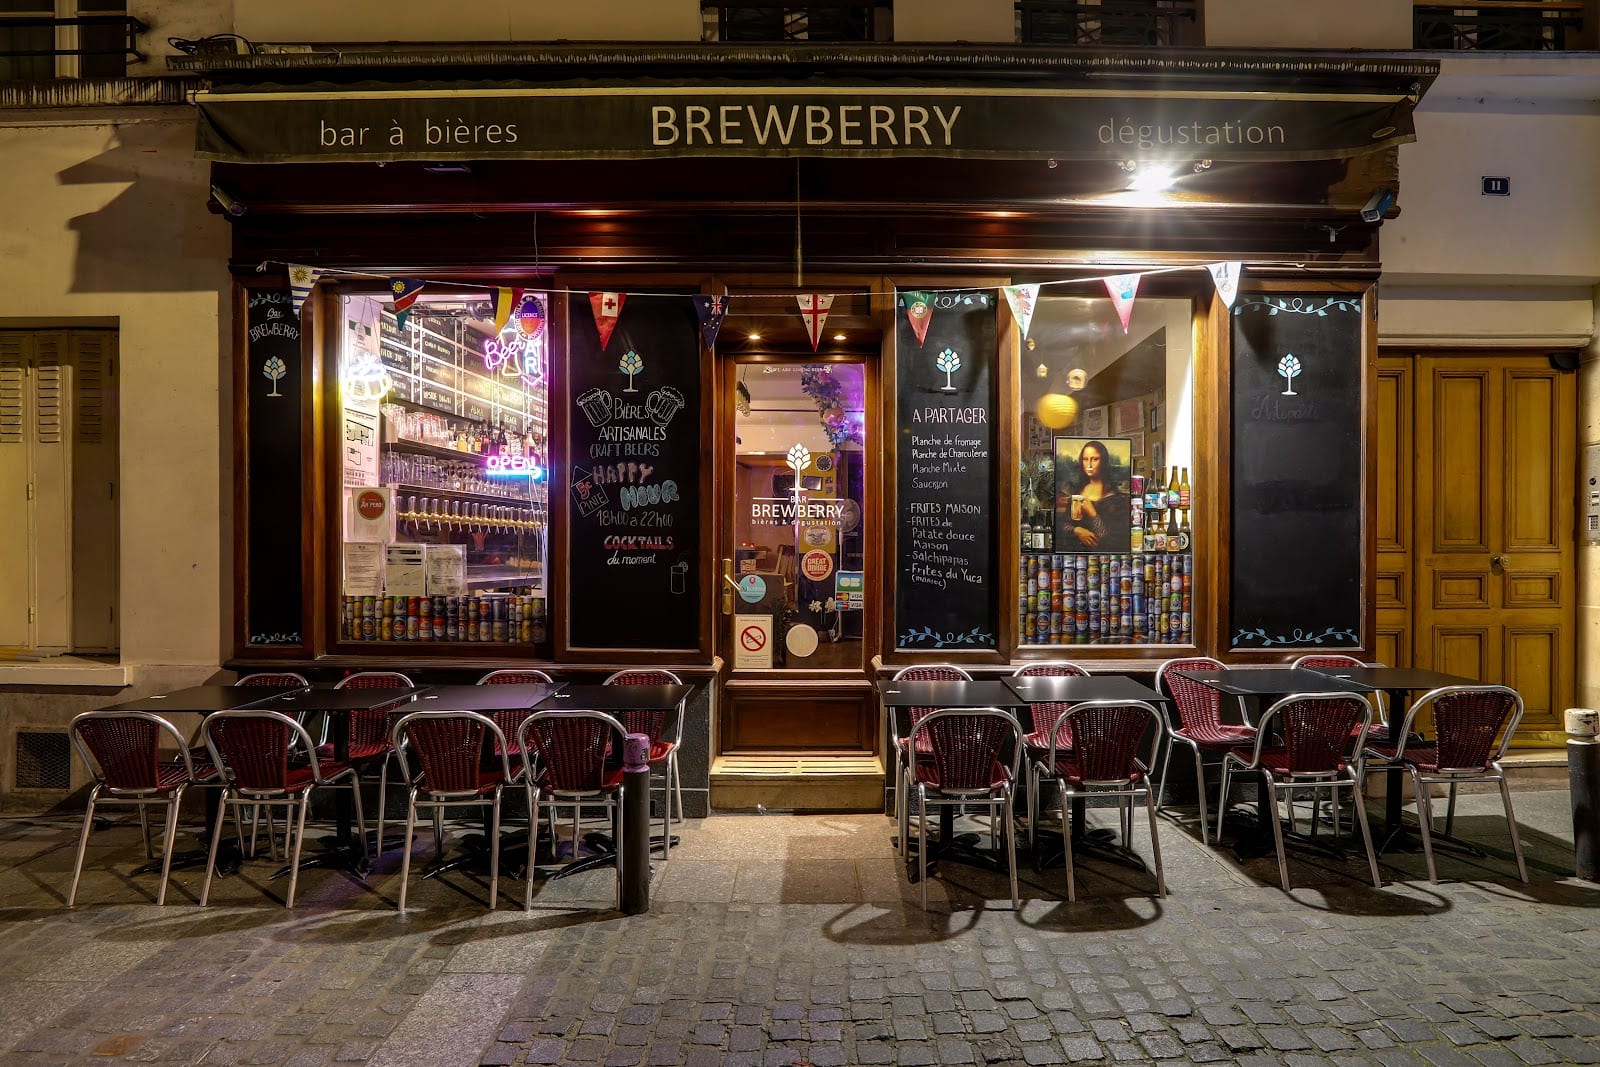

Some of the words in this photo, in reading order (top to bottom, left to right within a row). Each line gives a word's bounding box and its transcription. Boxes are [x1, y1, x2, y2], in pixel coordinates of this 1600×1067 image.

[320, 119, 369, 147] bar
[389, 118, 404, 146] à
[425, 118, 518, 145] bières
[651, 105, 961, 146] BREWBERRY
[1098, 117, 1285, 150] dégustation
[1491, 180, 1501, 191] 11
[249, 322, 300, 342] BREWBERRY
[485, 339, 526, 370] Beer
[912, 408, 922, 423] A
[924, 407, 987, 424] PARTAGER
[598, 426, 667, 442] ARTISANALES
[911, 434, 942, 446] Planche
[943, 434, 953, 446] de
[955, 434, 981, 449] fromage
[589, 443, 622, 459] CRAFT
[624, 442, 660, 457] BEERS
[912, 448, 937, 460] Planche
[938, 448, 948, 459] de
[948, 447, 988, 459] Charcuterie
[486, 455, 537, 472] OPEN
[912, 463, 940, 474] Planche
[592, 462, 654, 485] HAPPY
[620, 479, 680, 512] HOUR
[751, 504, 845, 518] BREWBERRY
[910, 502, 941, 514] FRITES
[945, 503, 981, 515] MAISON
[911, 516, 940, 527] FRITES
[942, 517, 953, 528] de
[912, 527, 944, 540] Patate
[946, 530, 976, 541] douce
[603, 534, 675, 551] COCKTAILS
[913, 539, 949, 552] Maison
[607, 550, 620, 566] du
[621, 553, 657, 566] moment
[911, 550, 969, 566] Salchipapas
[911, 562, 943, 578] Frites
[945, 567, 958, 579] du
[960, 567, 982, 584] Yuca
